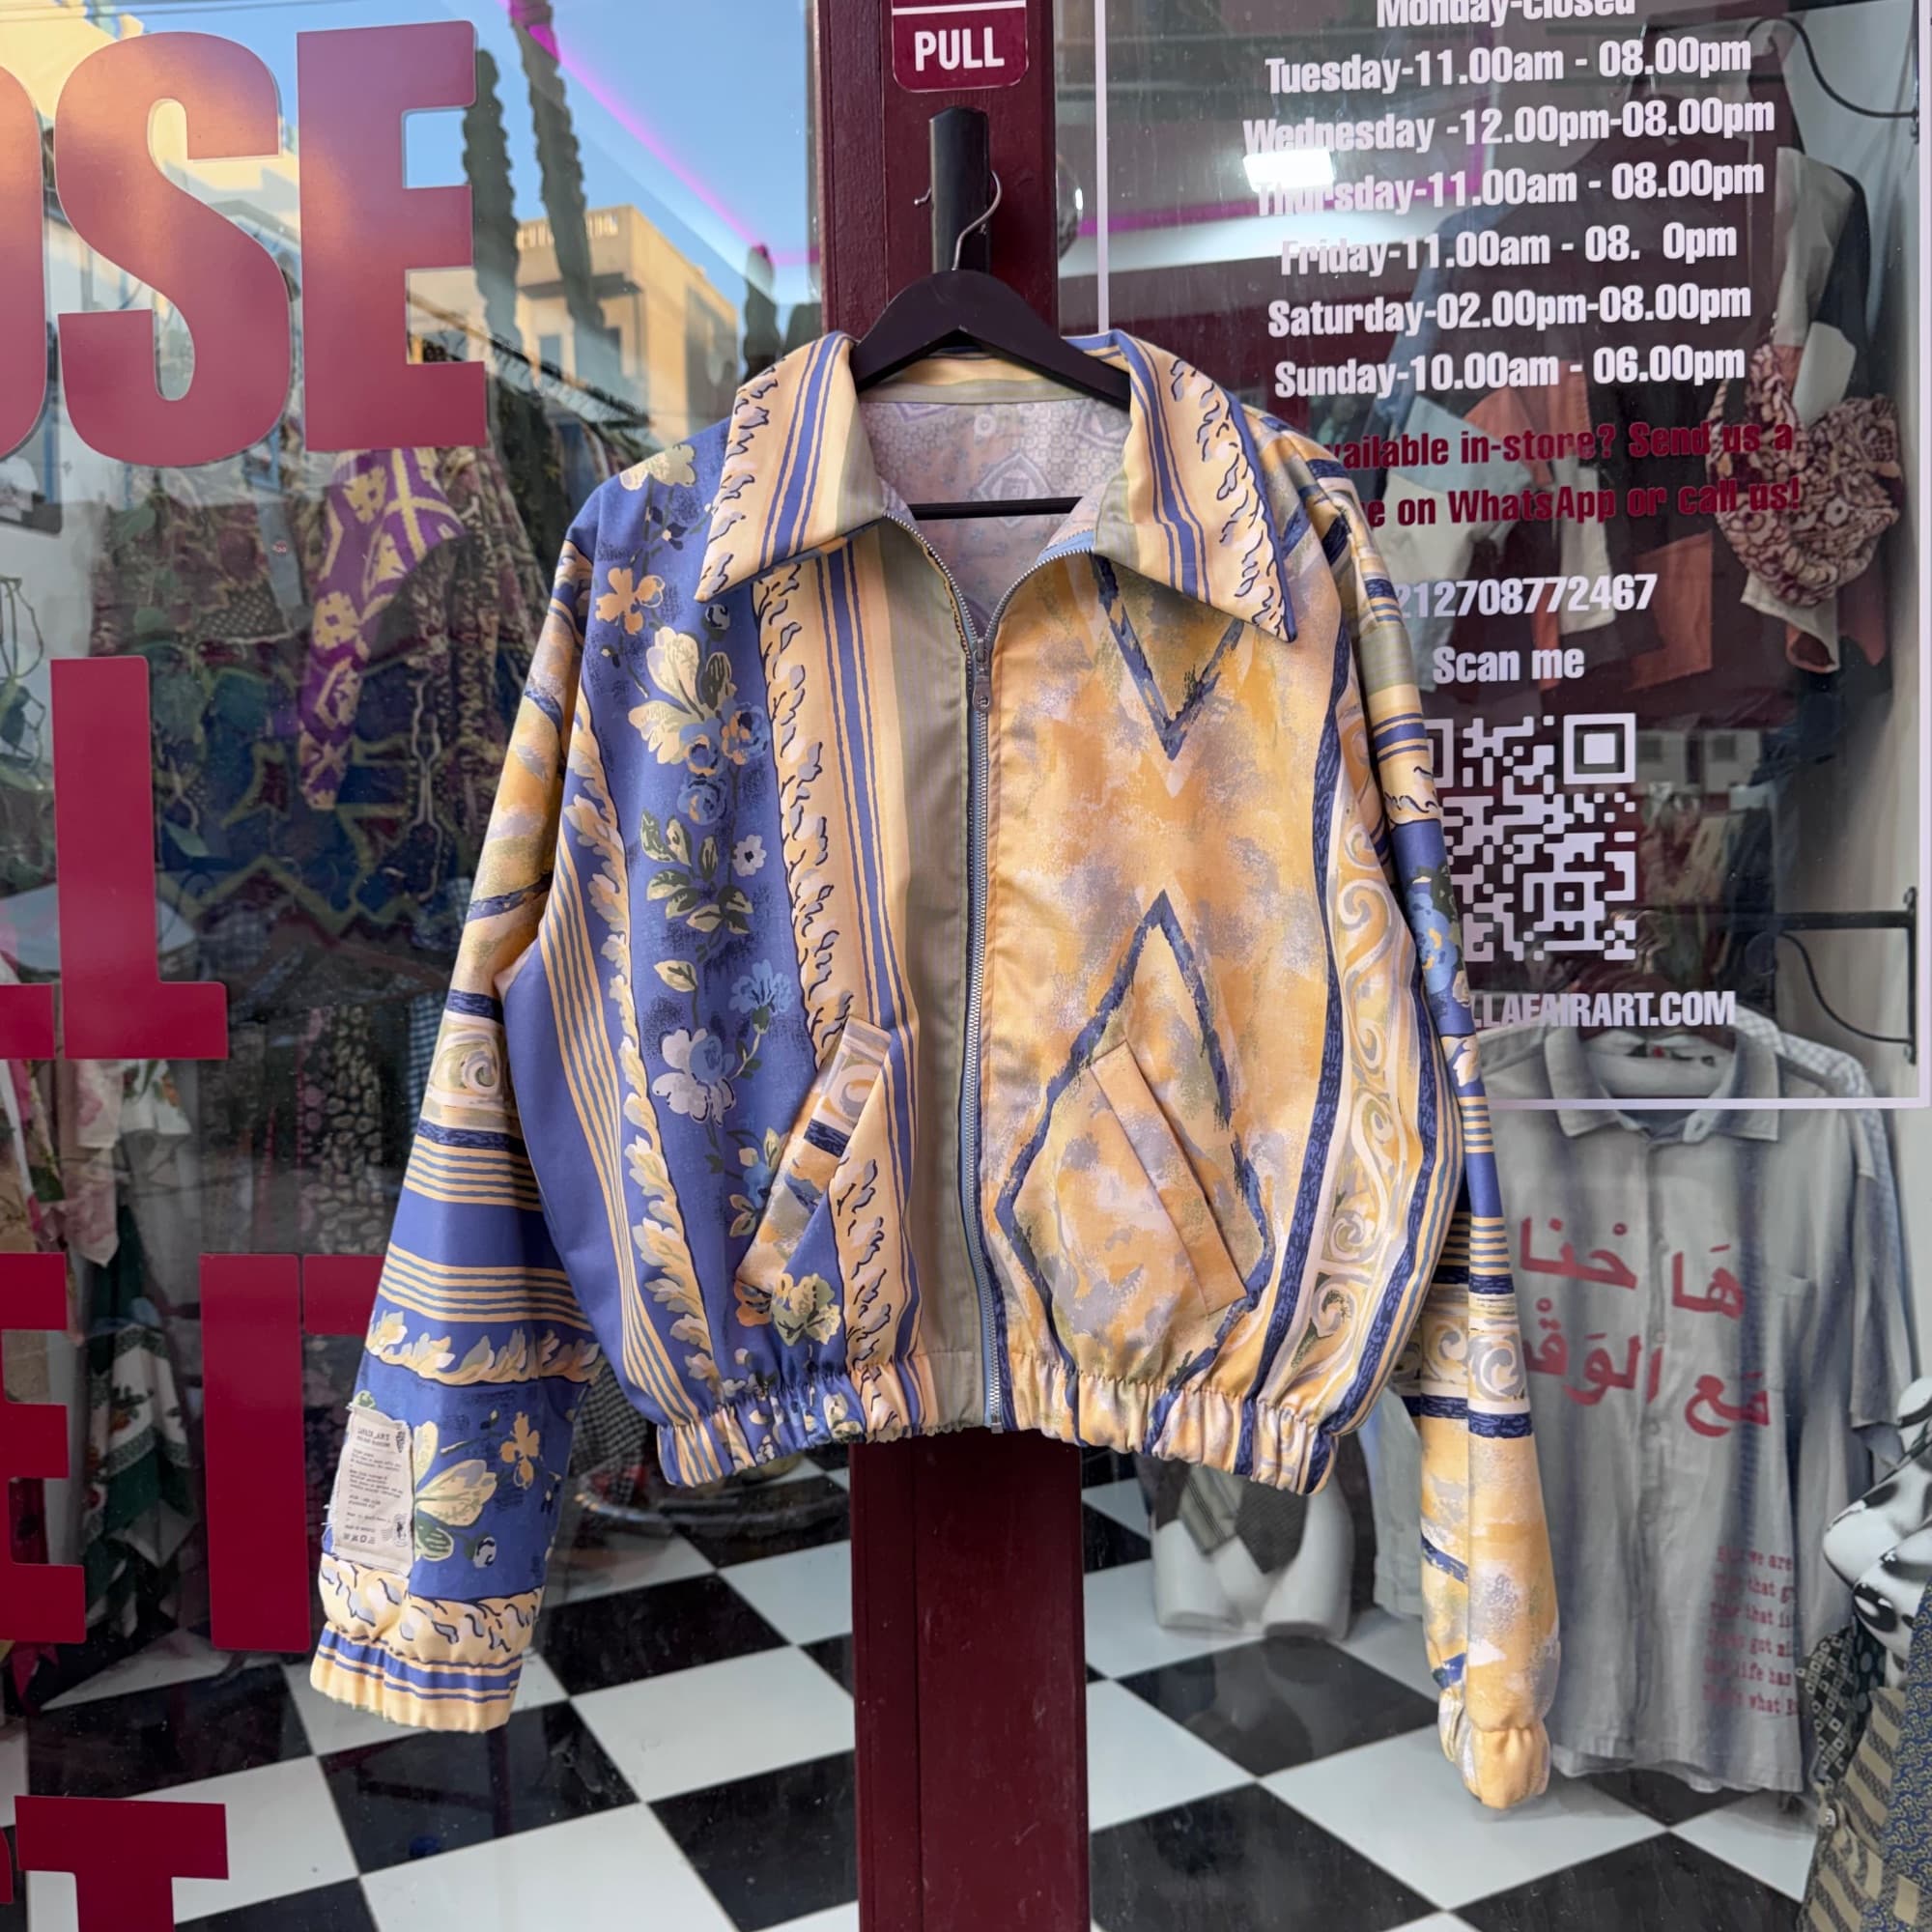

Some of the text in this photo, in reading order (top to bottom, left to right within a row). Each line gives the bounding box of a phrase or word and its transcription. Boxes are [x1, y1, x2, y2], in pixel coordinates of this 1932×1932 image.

[914, 27, 1005, 71] PULL
[1264, 46, 1564, 94] Tuesday-11.00am
[1599, 37, 1750, 77] 08.00pm
[1243, 98, 1776, 153] Wednesday -12.00pm-08.00pm
[1612, 159, 1764, 201] 08.00pm
[0, 21, 487, 469] SE
[1281, 230, 1550, 277] Friday-11.00am
[1268, 283, 1750, 337] Saturday-02.00pm-08.00pm
[1275, 352, 1559, 400] Sunday-10.00am
[1594, 344, 1745, 385] 06.00pm
[1461, 424, 1616, 464] in-store?
[1629, 421, 1711, 458] Send
[1722, 424, 1762, 452] us
[1774, 423, 1793, 451] a
[1361, 477, 1800, 528] e on WhatsApp or call us!
[1433, 646, 1585, 684] Scan me
